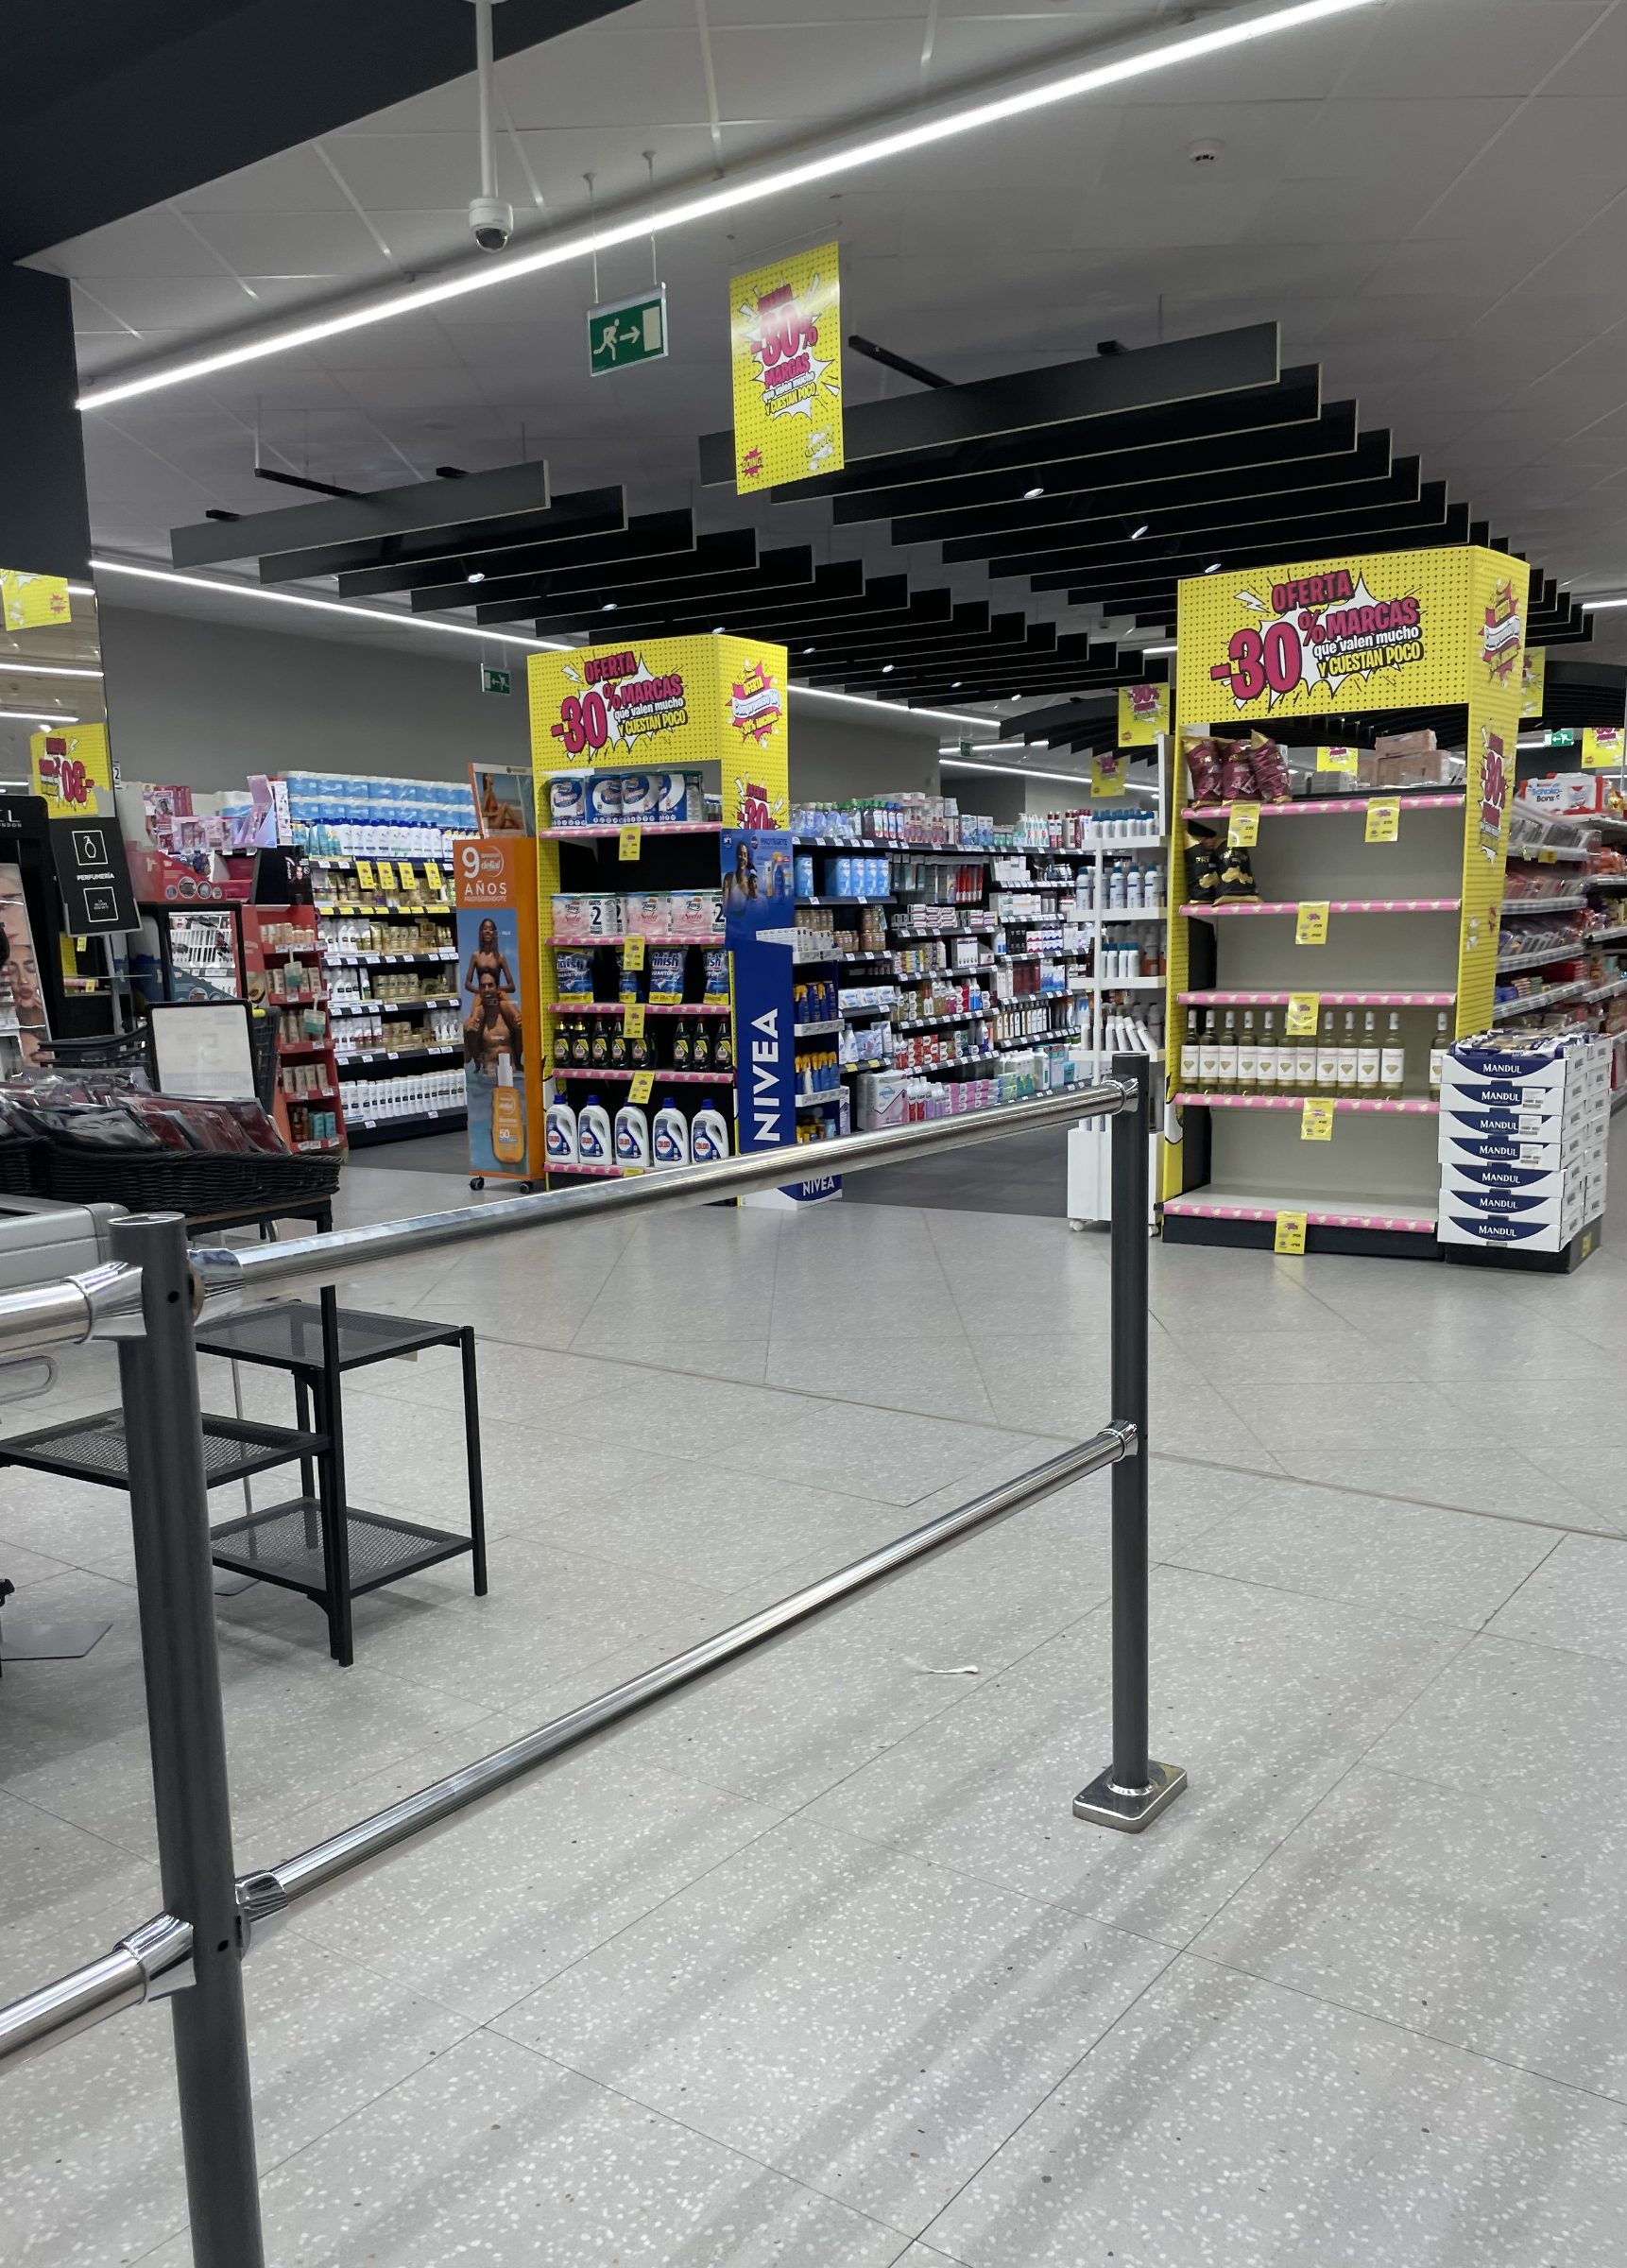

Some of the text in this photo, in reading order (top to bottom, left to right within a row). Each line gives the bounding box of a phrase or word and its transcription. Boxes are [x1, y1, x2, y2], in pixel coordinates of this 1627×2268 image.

[1272, 569, 1355, 614] OFERTA
[1326, 596, 1420, 641] MARCAS
[1312, 627, 1420, 661] que valen mucho
[584, 651, 639, 685] OFERTA
[1317, 641, 1424, 678] Y CUESTAN POCO
[620, 674, 684, 706] MARCAS
[614, 696, 685, 722] que valen mucho
[617, 709, 689, 737] Y CUESTAN POCO
[77, 871, 115, 881] PERFUMERÍA
[464, 880, 507, 895] AÑOS
[687, 900, 702, 911] Foxy
[750, 1008, 780, 1142] NIVEA
[1482, 1062, 1522, 1074] MANDUL
[1481, 1090, 1520, 1102] MANDUL
[1480, 1119, 1518, 1131] MANDUL
[1479, 1144, 1518, 1157] MANDUL
[802, 1177, 835, 1196] NIVEA
[1481, 1172, 1521, 1184] MANDUL
[1480, 1197, 1518, 1210] MANDUL
[1478, 1225, 1517, 1237] MANDUL
